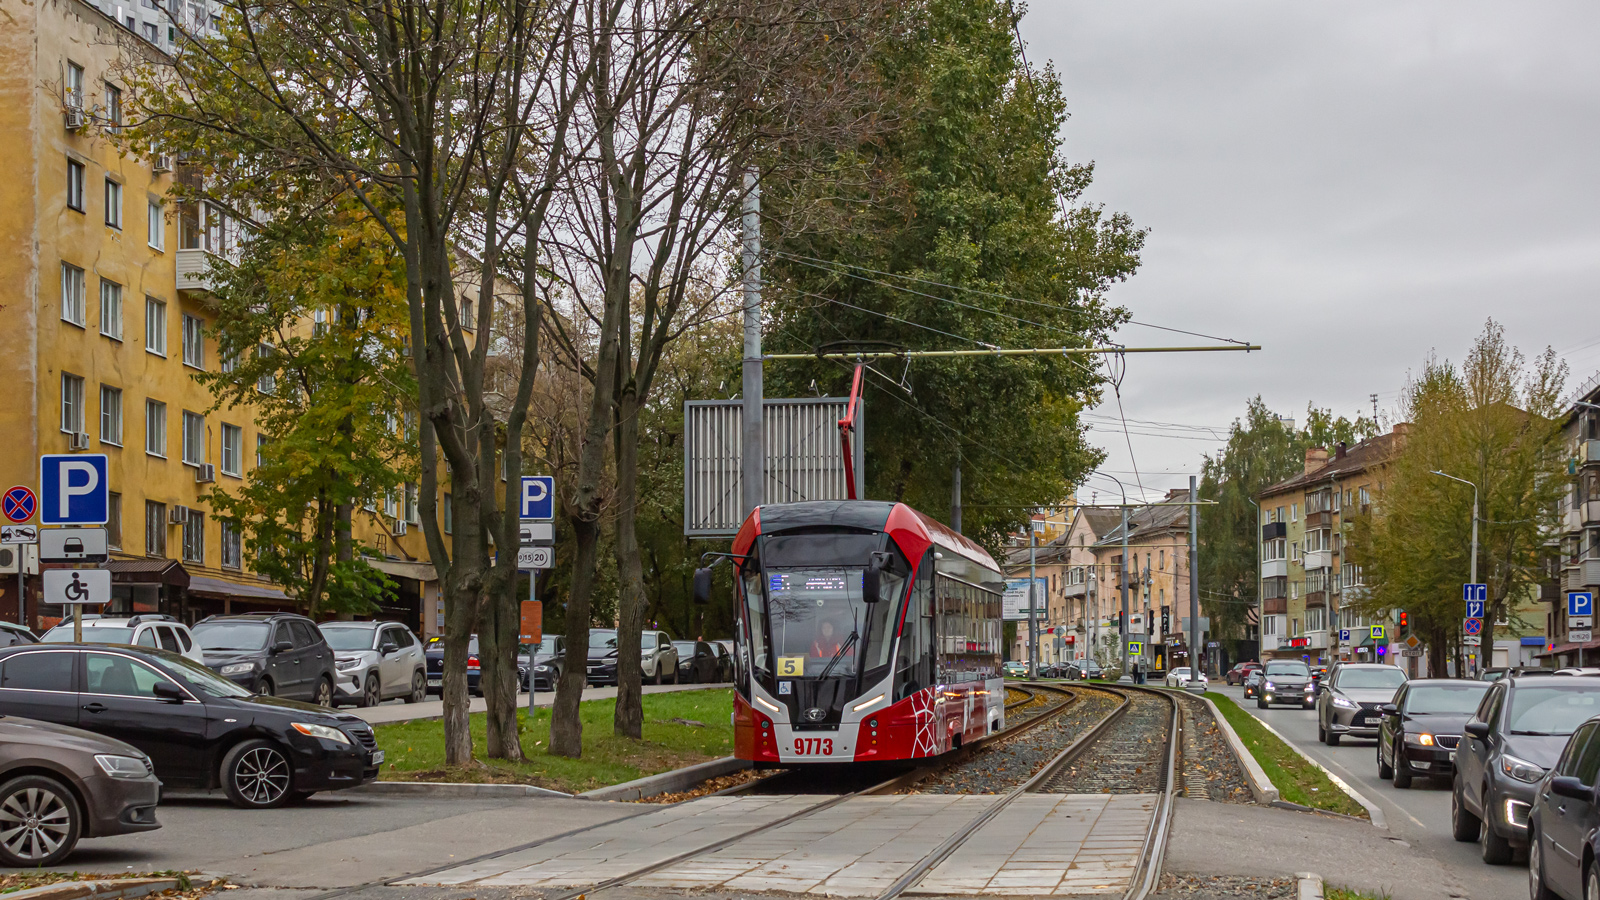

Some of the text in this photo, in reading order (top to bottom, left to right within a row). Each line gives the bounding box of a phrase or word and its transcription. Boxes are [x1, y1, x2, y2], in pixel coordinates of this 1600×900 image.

[59, 461, 99, 518] P
[522, 480, 548, 516] P
[534, 553, 545, 562] 20
[1574, 595, 1588, 613] P
[1342, 631, 1349, 640] P
[783, 660, 796, 674] 5
[794, 737, 833, 756] 9773
